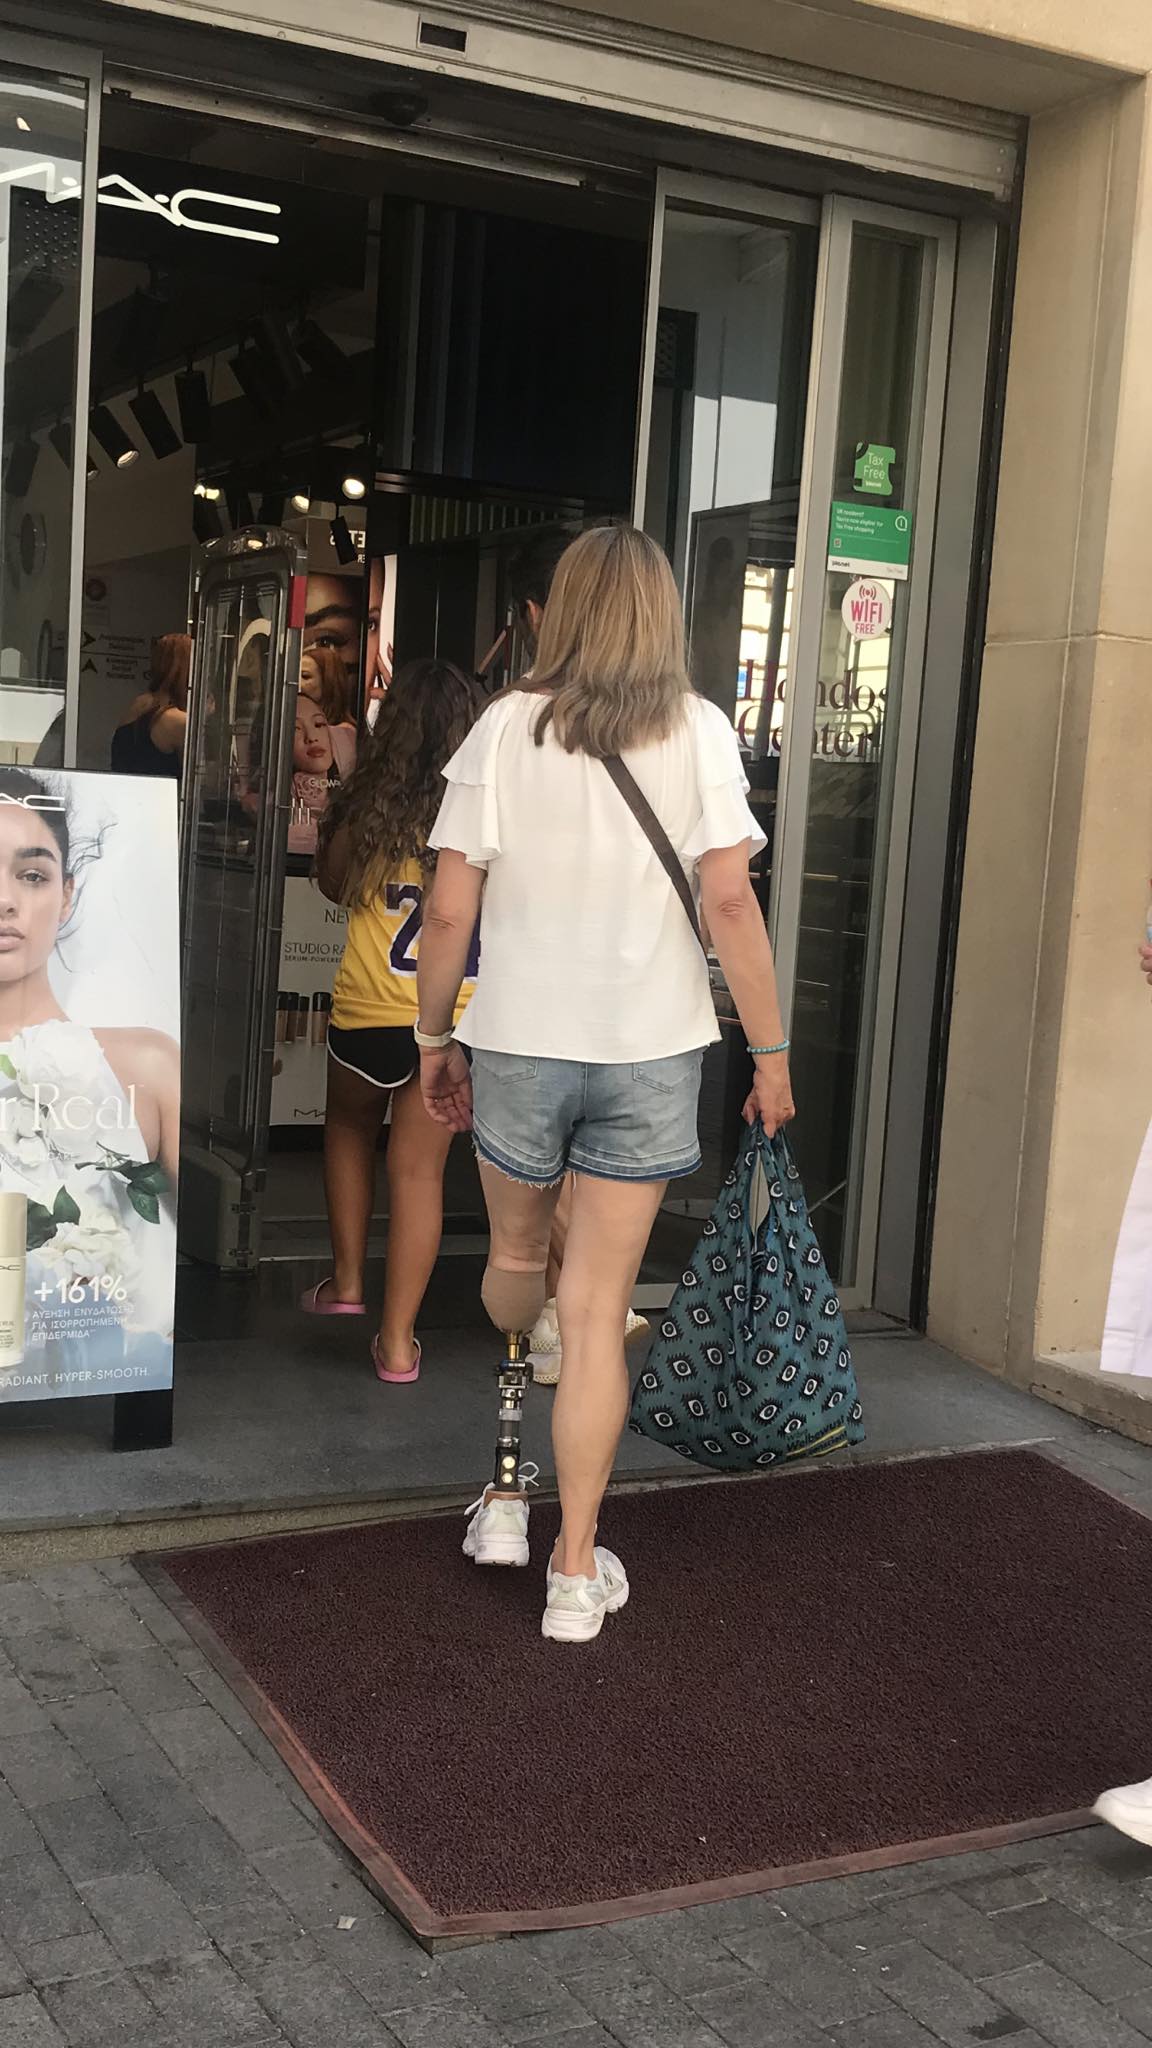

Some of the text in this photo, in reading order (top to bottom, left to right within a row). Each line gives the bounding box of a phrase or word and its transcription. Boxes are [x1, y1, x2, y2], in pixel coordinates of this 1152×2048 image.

[868, 452, 885, 466] Tax
[863, 465, 886, 480] Free
[851, 599, 883, 624] WIFI
[855, 623, 876, 634] FREE
[284, 942, 331, 955] STUDIO
[34, 1274, 127, 1304] +161%
[32, 1308, 71, 1320] ΑΥΞΗΣΗ
[32, 1321, 47, 1330] ΓΙΑ
